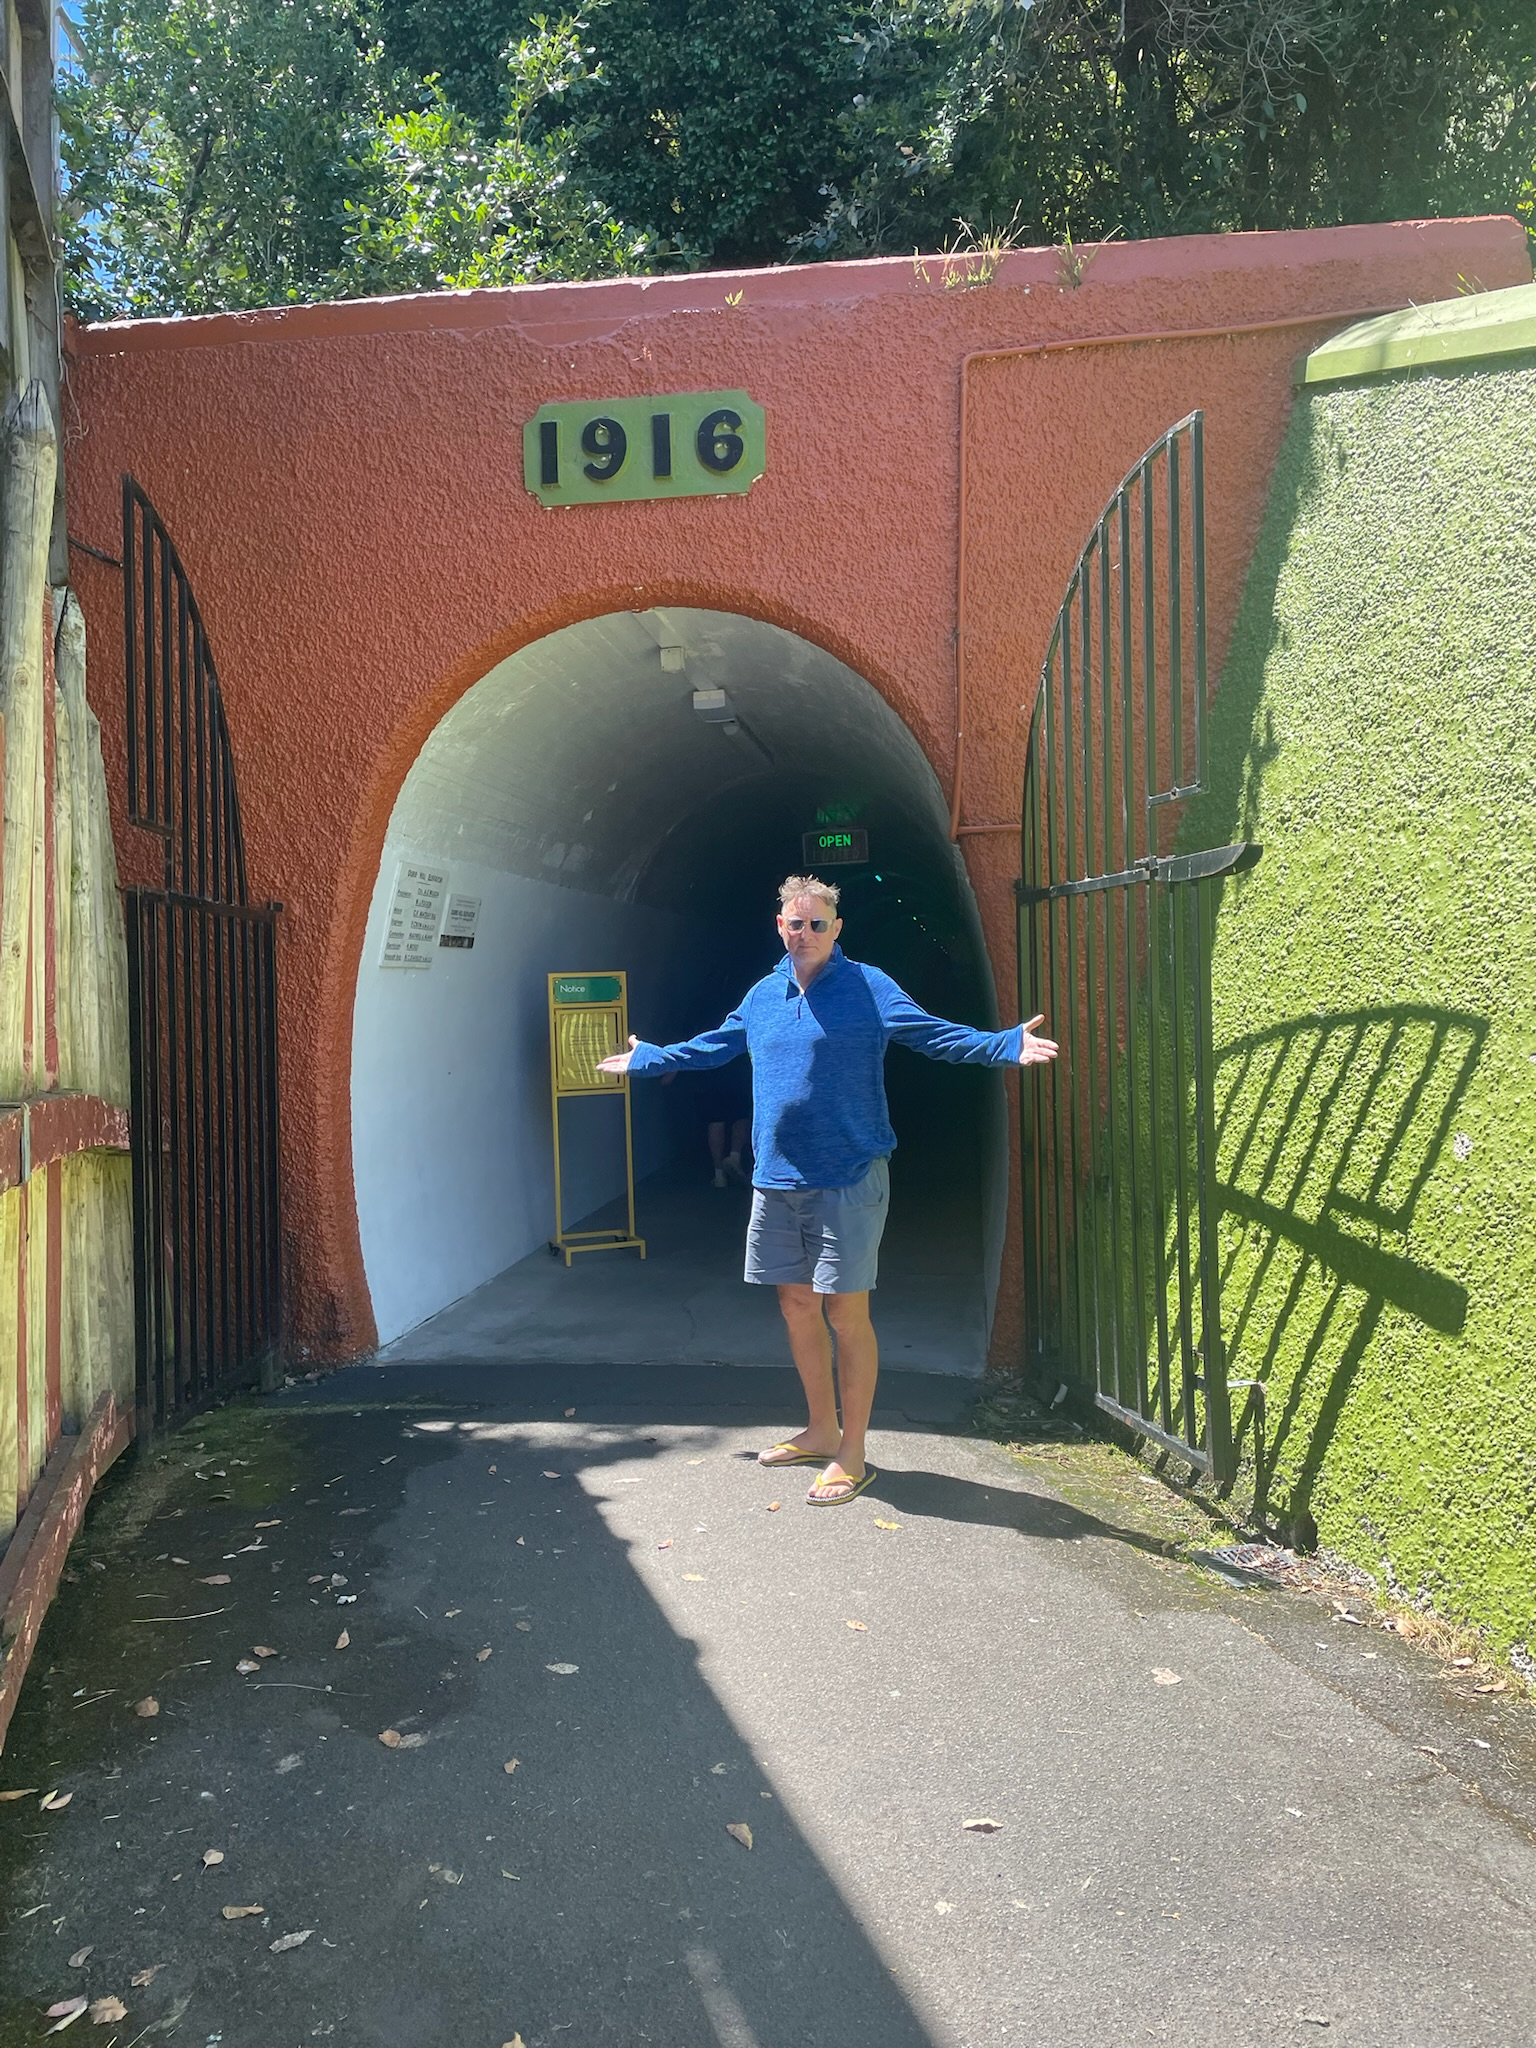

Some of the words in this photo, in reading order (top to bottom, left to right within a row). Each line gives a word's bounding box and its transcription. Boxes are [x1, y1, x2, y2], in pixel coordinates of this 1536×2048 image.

[541, 409, 745, 486] 1916
[819, 834, 851, 847] OPEN
[560, 985, 585, 993] Notice
